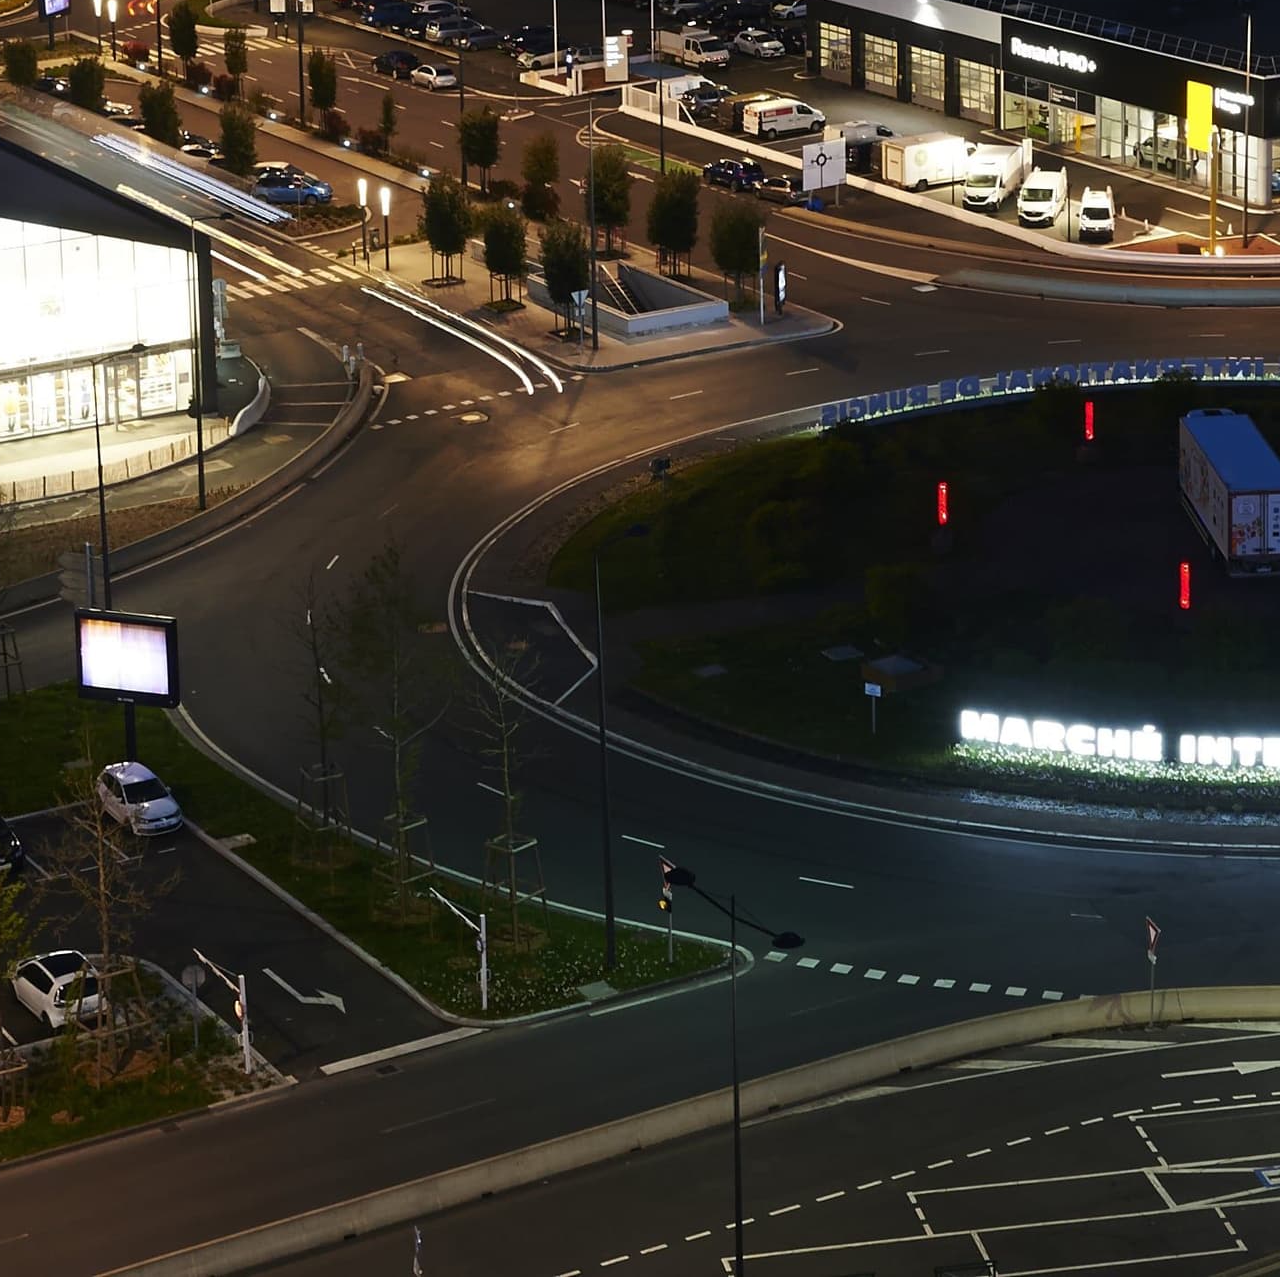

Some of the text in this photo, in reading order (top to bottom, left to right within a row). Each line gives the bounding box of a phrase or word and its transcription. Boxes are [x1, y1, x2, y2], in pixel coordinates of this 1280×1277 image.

[1010, 36, 1098, 74] Renault PRO+
[961, 709, 1163, 762] MARCHÉ
